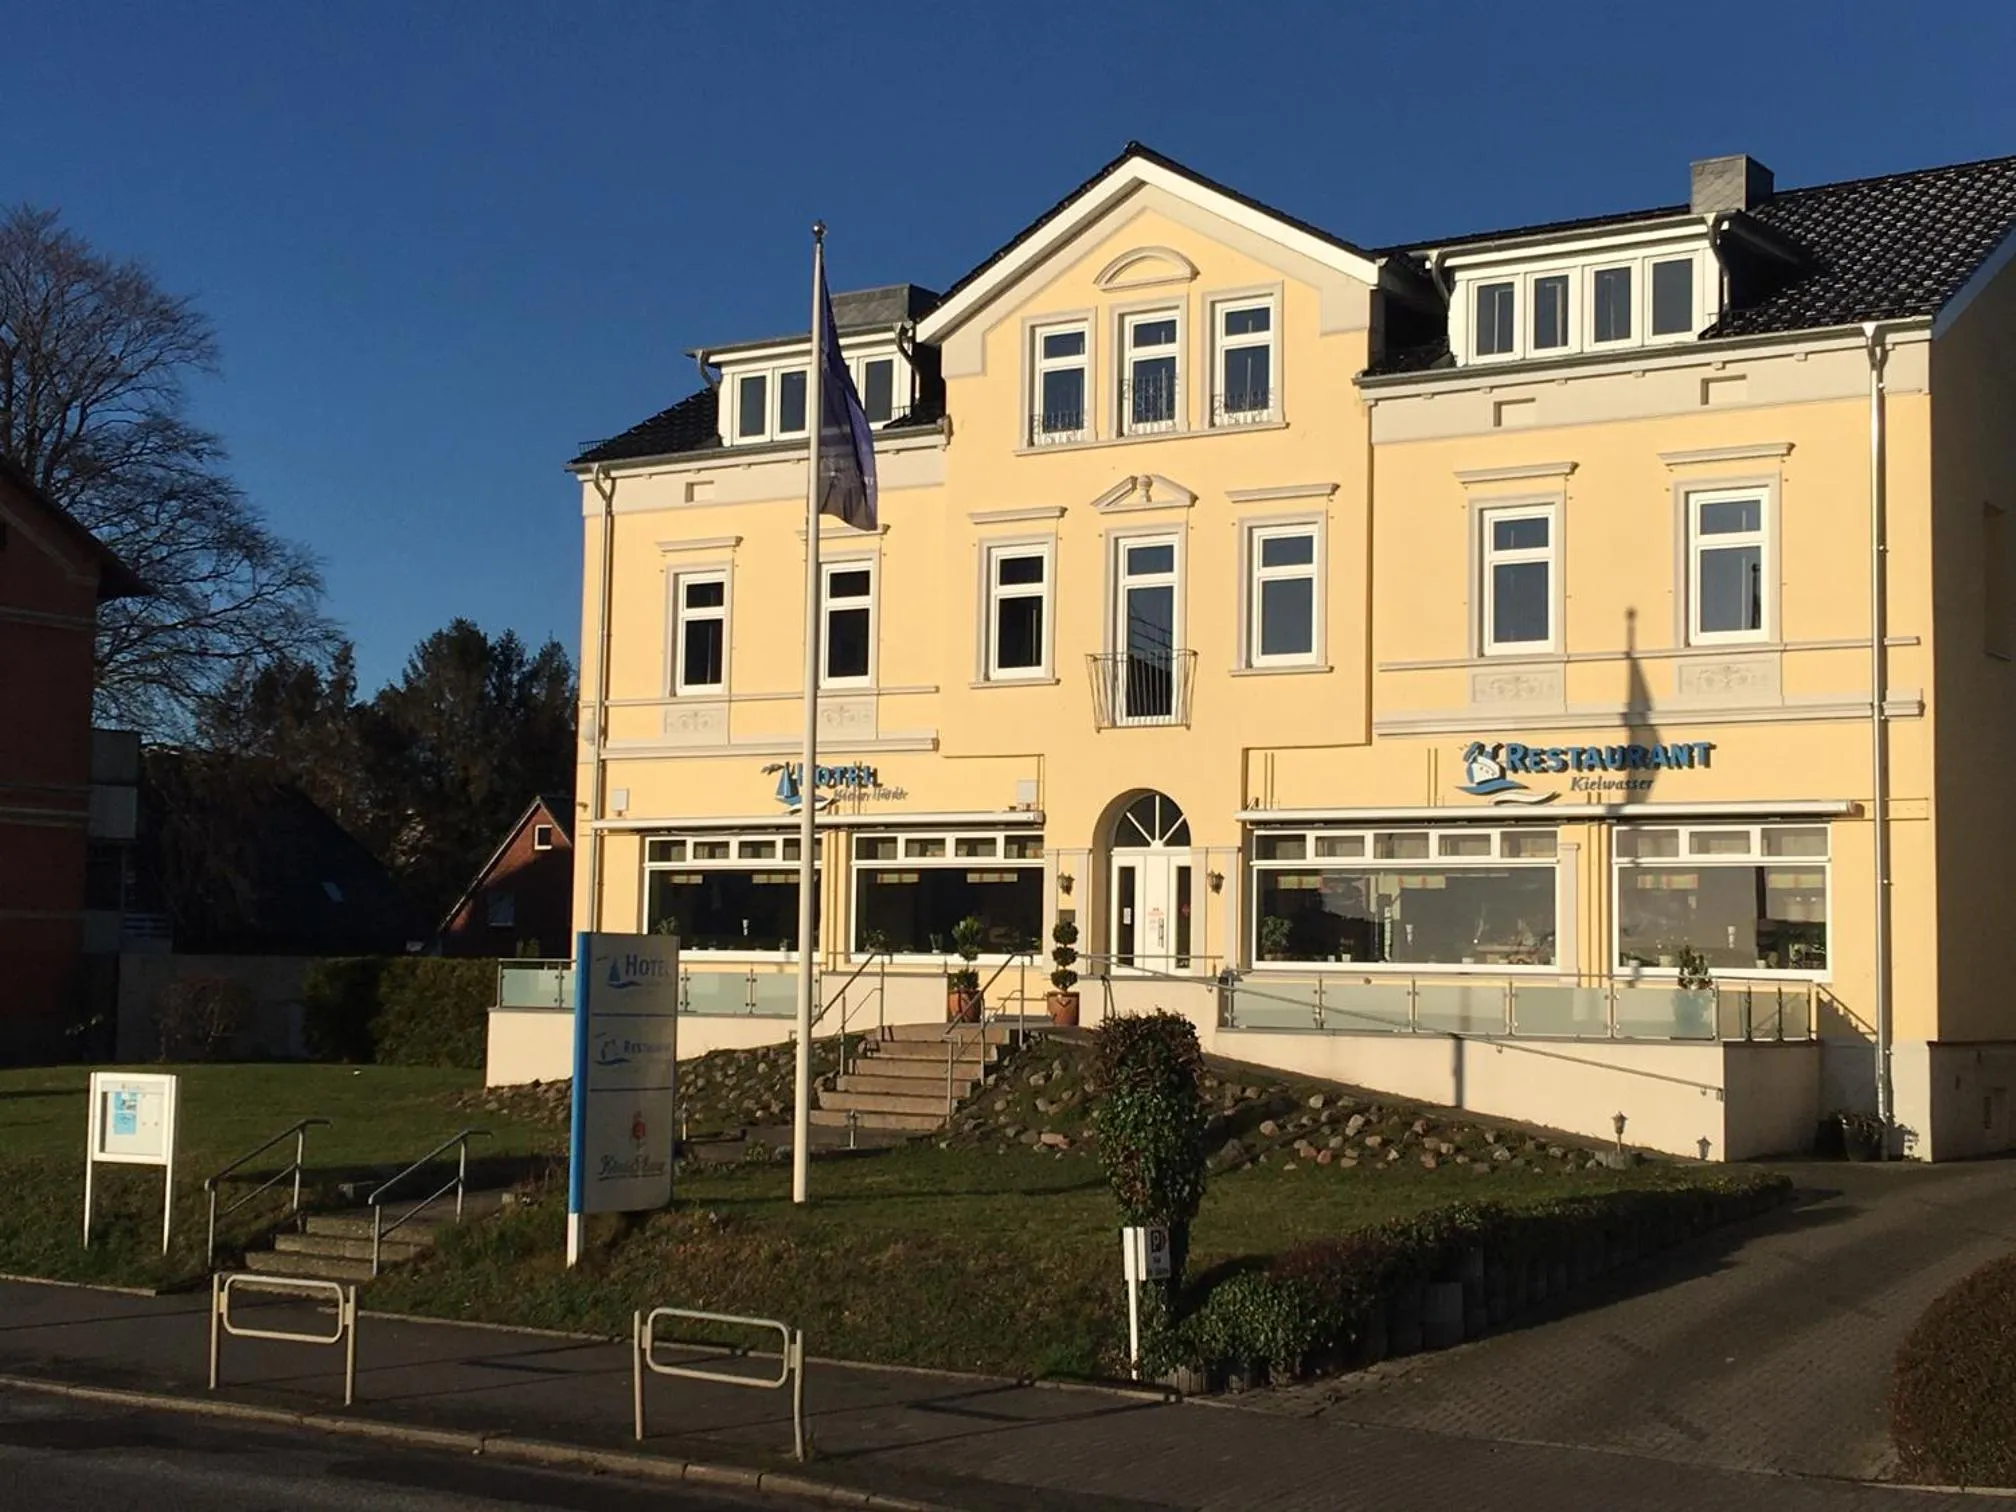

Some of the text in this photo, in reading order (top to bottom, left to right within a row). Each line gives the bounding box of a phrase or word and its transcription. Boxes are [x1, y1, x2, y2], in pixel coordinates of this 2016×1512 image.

[1504, 741, 1712, 772] RESTAURANT
[1569, 775, 1653, 791] Kielwasser
[624, 1040, 671, 1054] RESTA
